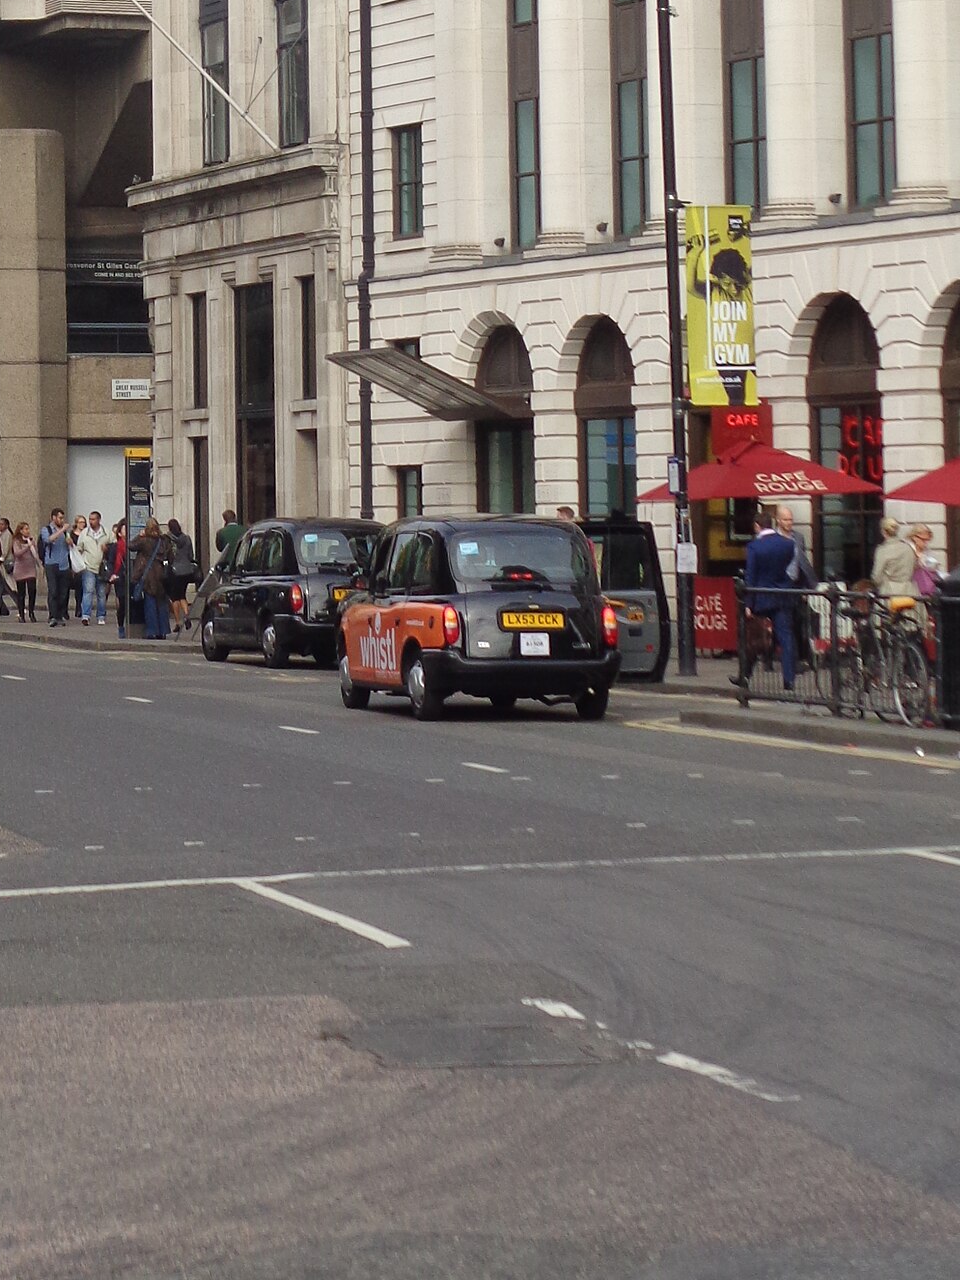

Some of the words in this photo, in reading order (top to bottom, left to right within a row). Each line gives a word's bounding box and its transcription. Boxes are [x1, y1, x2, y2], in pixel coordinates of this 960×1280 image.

[712, 301, 748, 321] JOIN
[713, 322, 737, 343] MY
[714, 344, 750, 365] GYM
[753, 479, 828, 493] ROUGE
[507, 615, 535, 625] LX53
[538, 615, 558, 625] CCK
[360, 611, 397, 671] whistl
